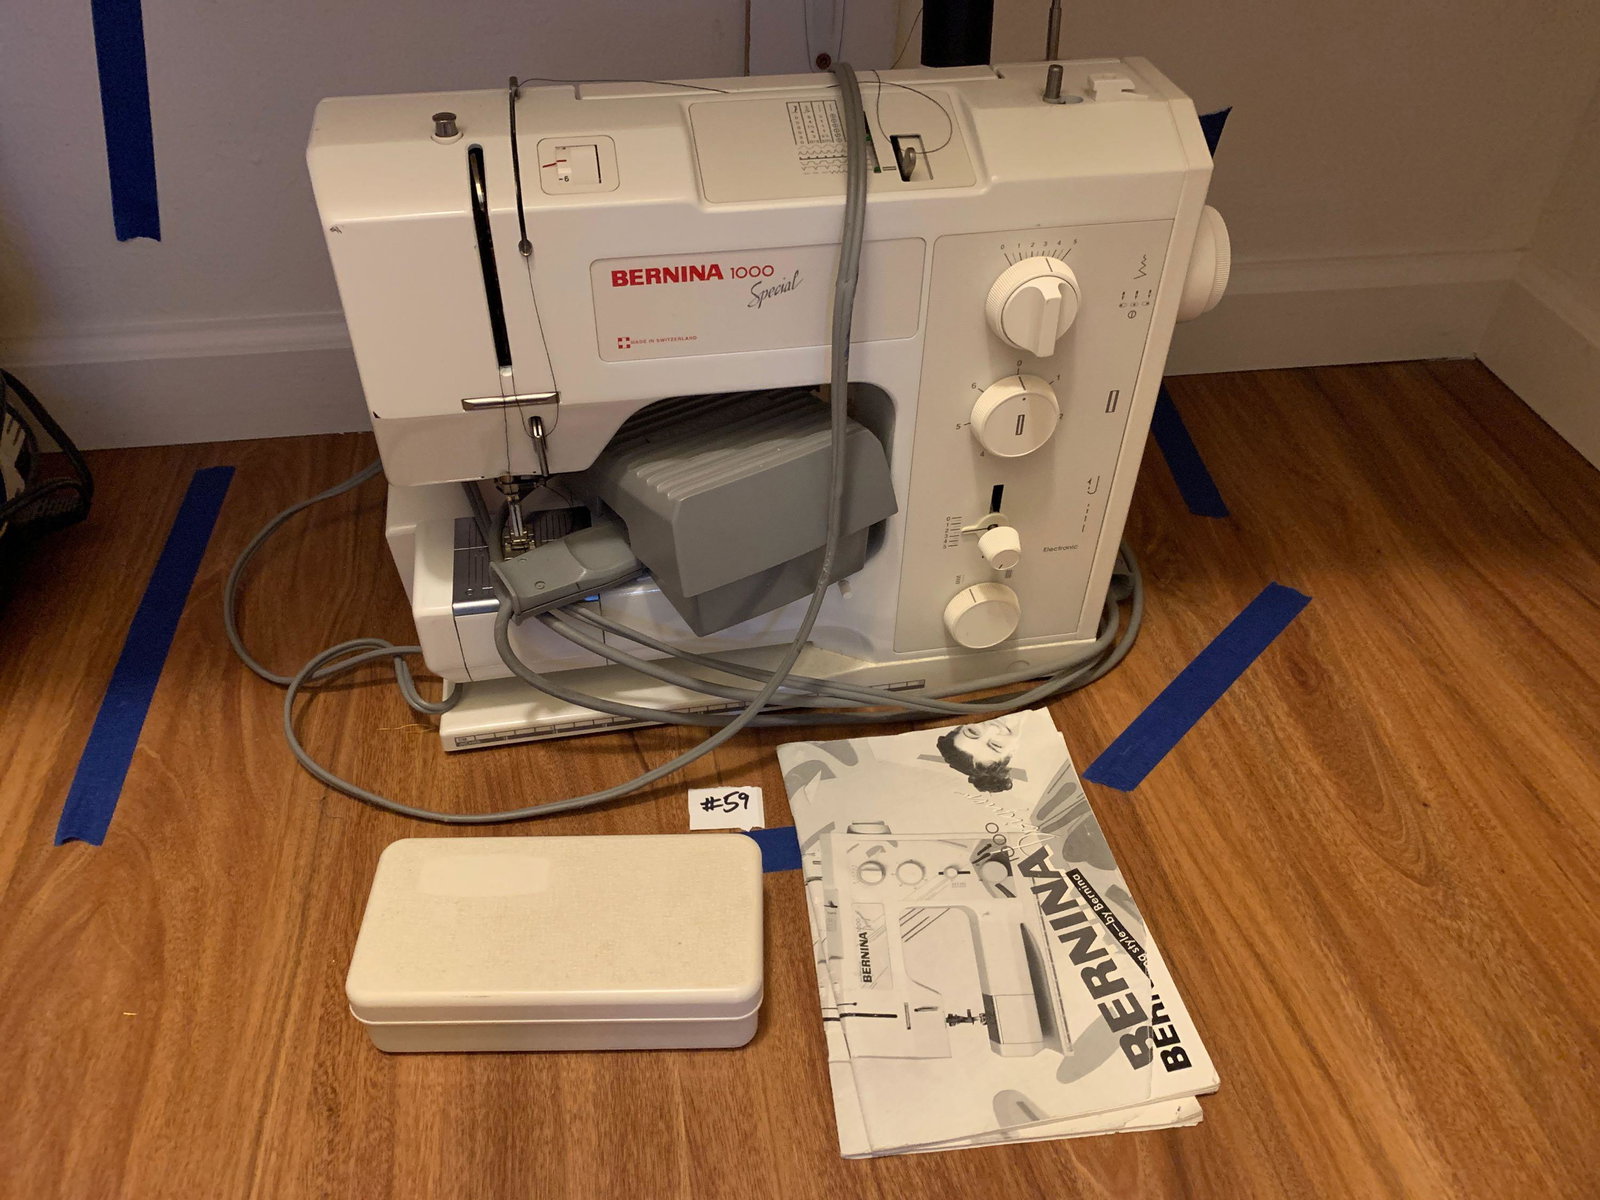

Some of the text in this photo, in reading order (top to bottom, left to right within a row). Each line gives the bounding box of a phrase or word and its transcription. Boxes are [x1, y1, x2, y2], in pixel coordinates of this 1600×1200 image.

[611, 263, 774, 287] BERNINA 1000
[747, 270, 804, 309] Special
[656, 335, 698, 343] SWITZERLAND
[1043, 544, 1079, 553] Electronic
[700, 791, 750, 813] #59
[1072, 873, 1105, 912] Bernina
[859, 931, 872, 983] BERNINA
[1017, 845, 1153, 1070] BERNINA
